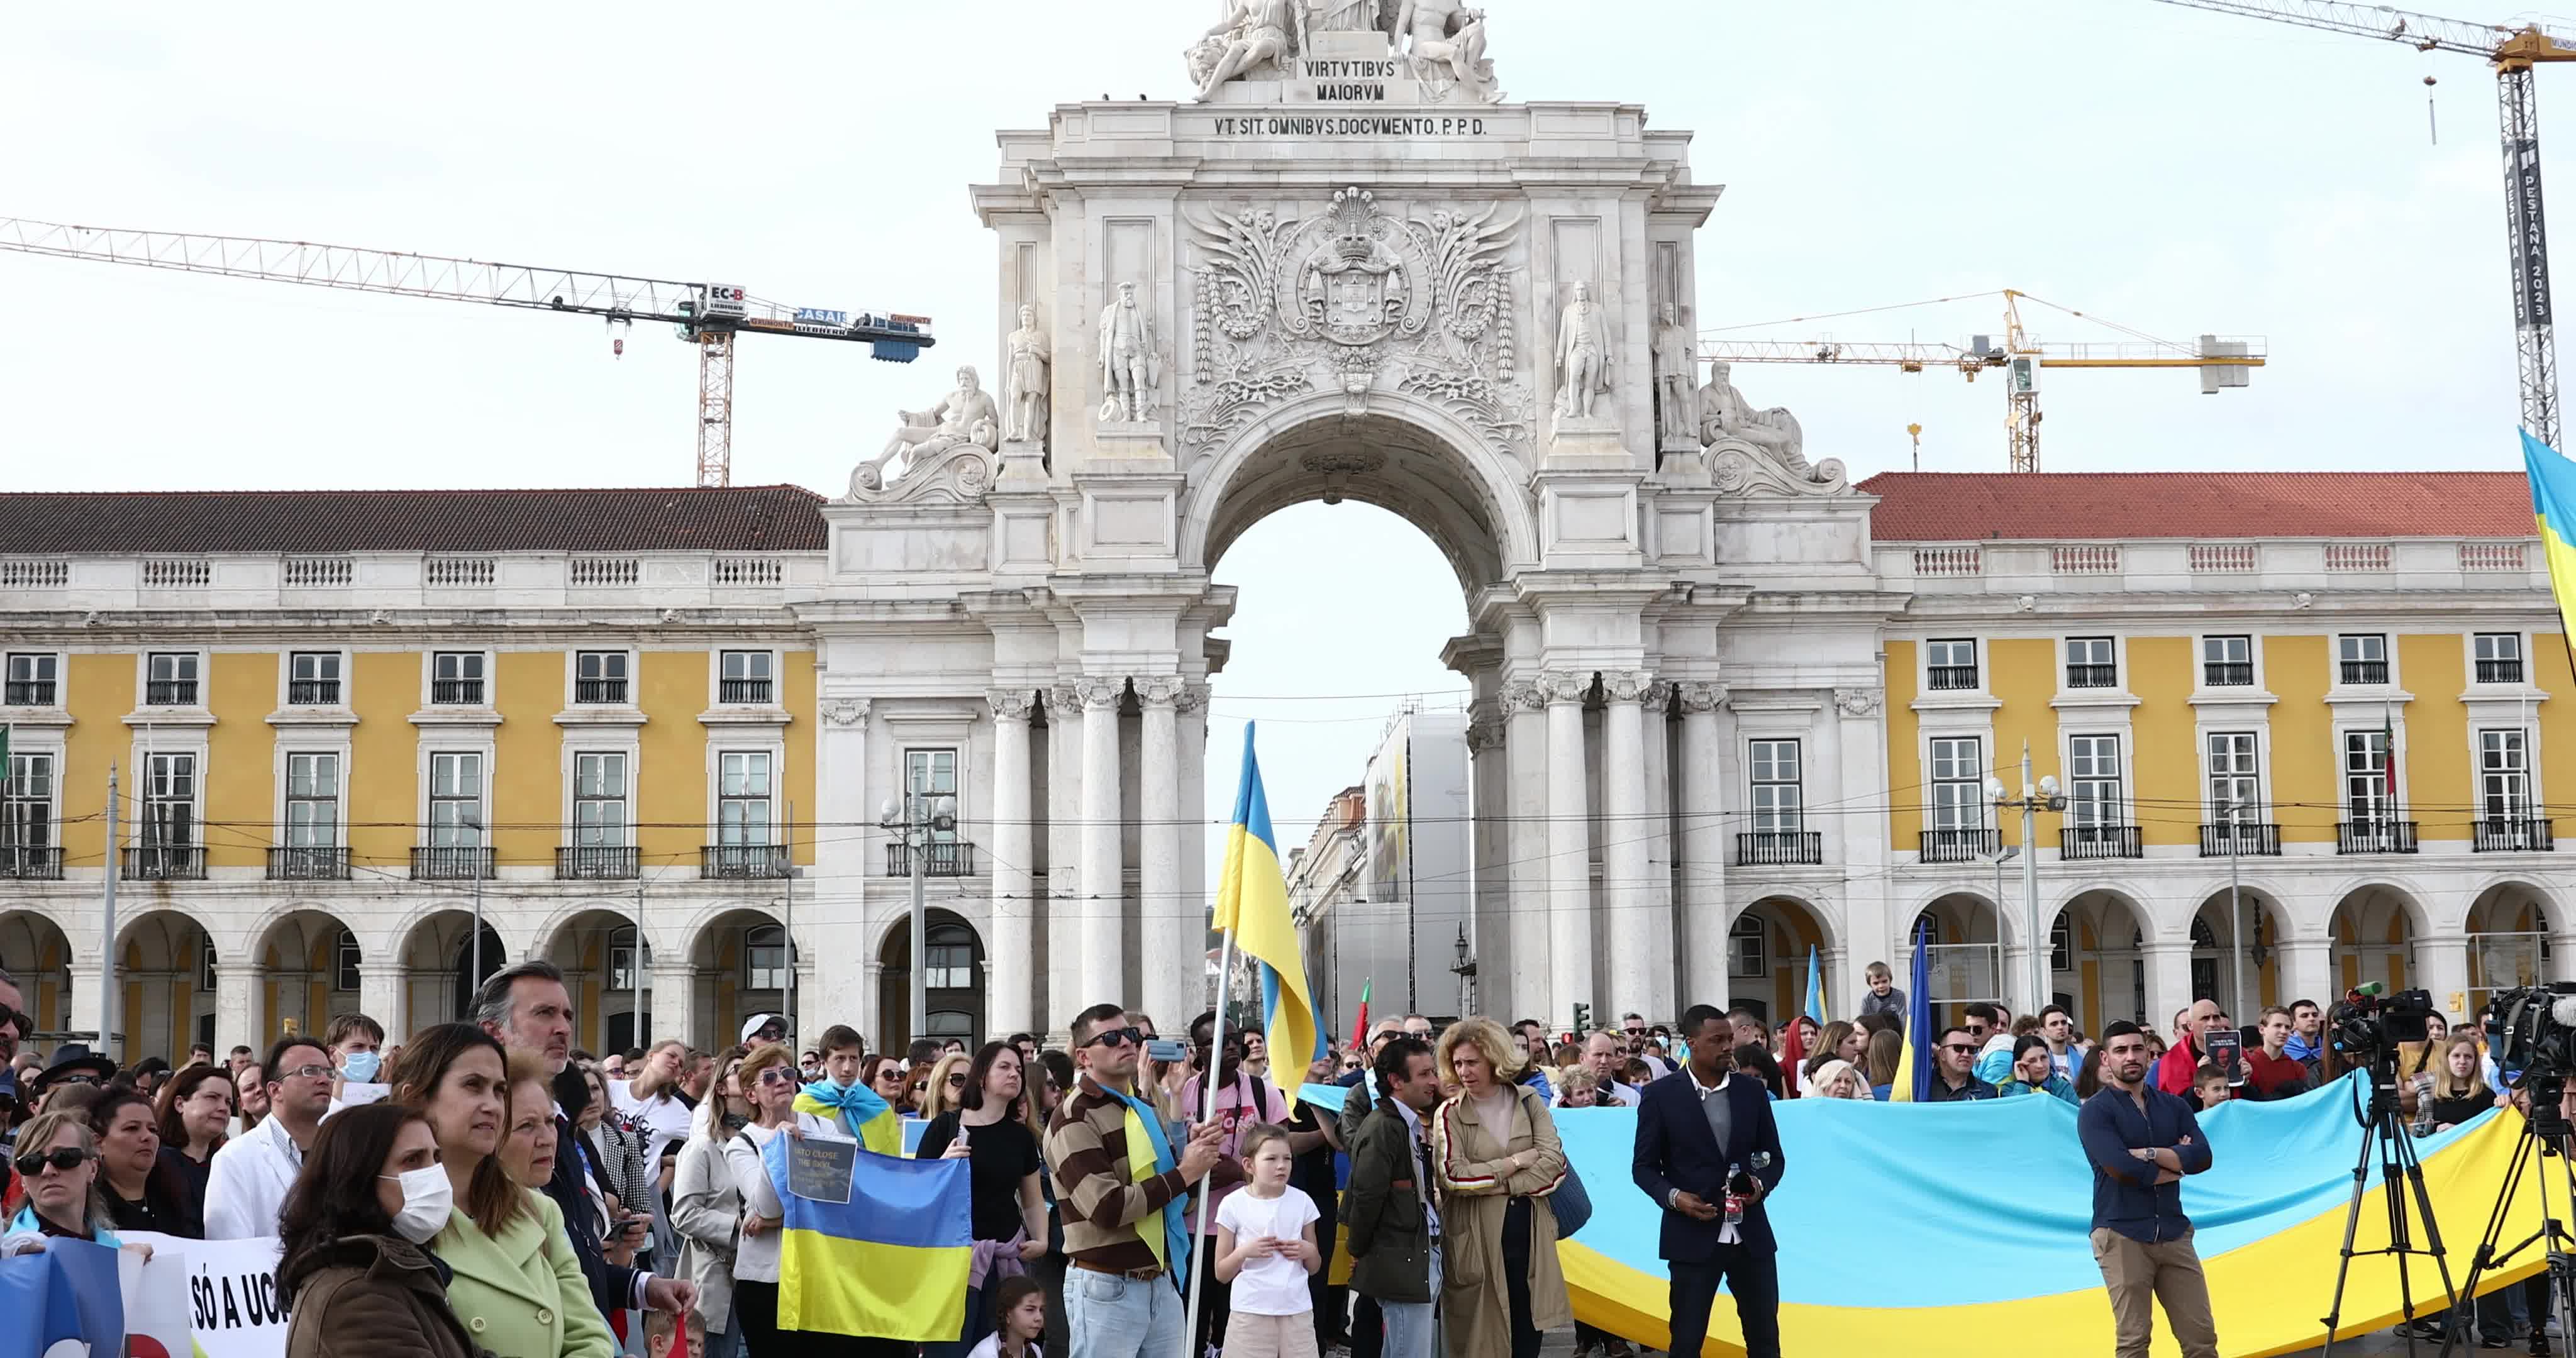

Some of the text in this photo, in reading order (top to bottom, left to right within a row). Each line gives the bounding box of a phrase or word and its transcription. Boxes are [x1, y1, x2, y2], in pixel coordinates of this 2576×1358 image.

[1304, 61, 1394, 77] VIRTVTIBVS
[1317, 84, 1384, 101] MAIORVM
[1214, 118, 1235, 135] VT.
[1240, 118, 1264, 135] SIT.
[2507, 178, 2523, 319] PESTANA 2023
[2525, 175, 2544, 316] PESTANA 2023
[712, 287, 743, 301] EC-B
[191, 1262, 288, 1330] SÓ A UC
